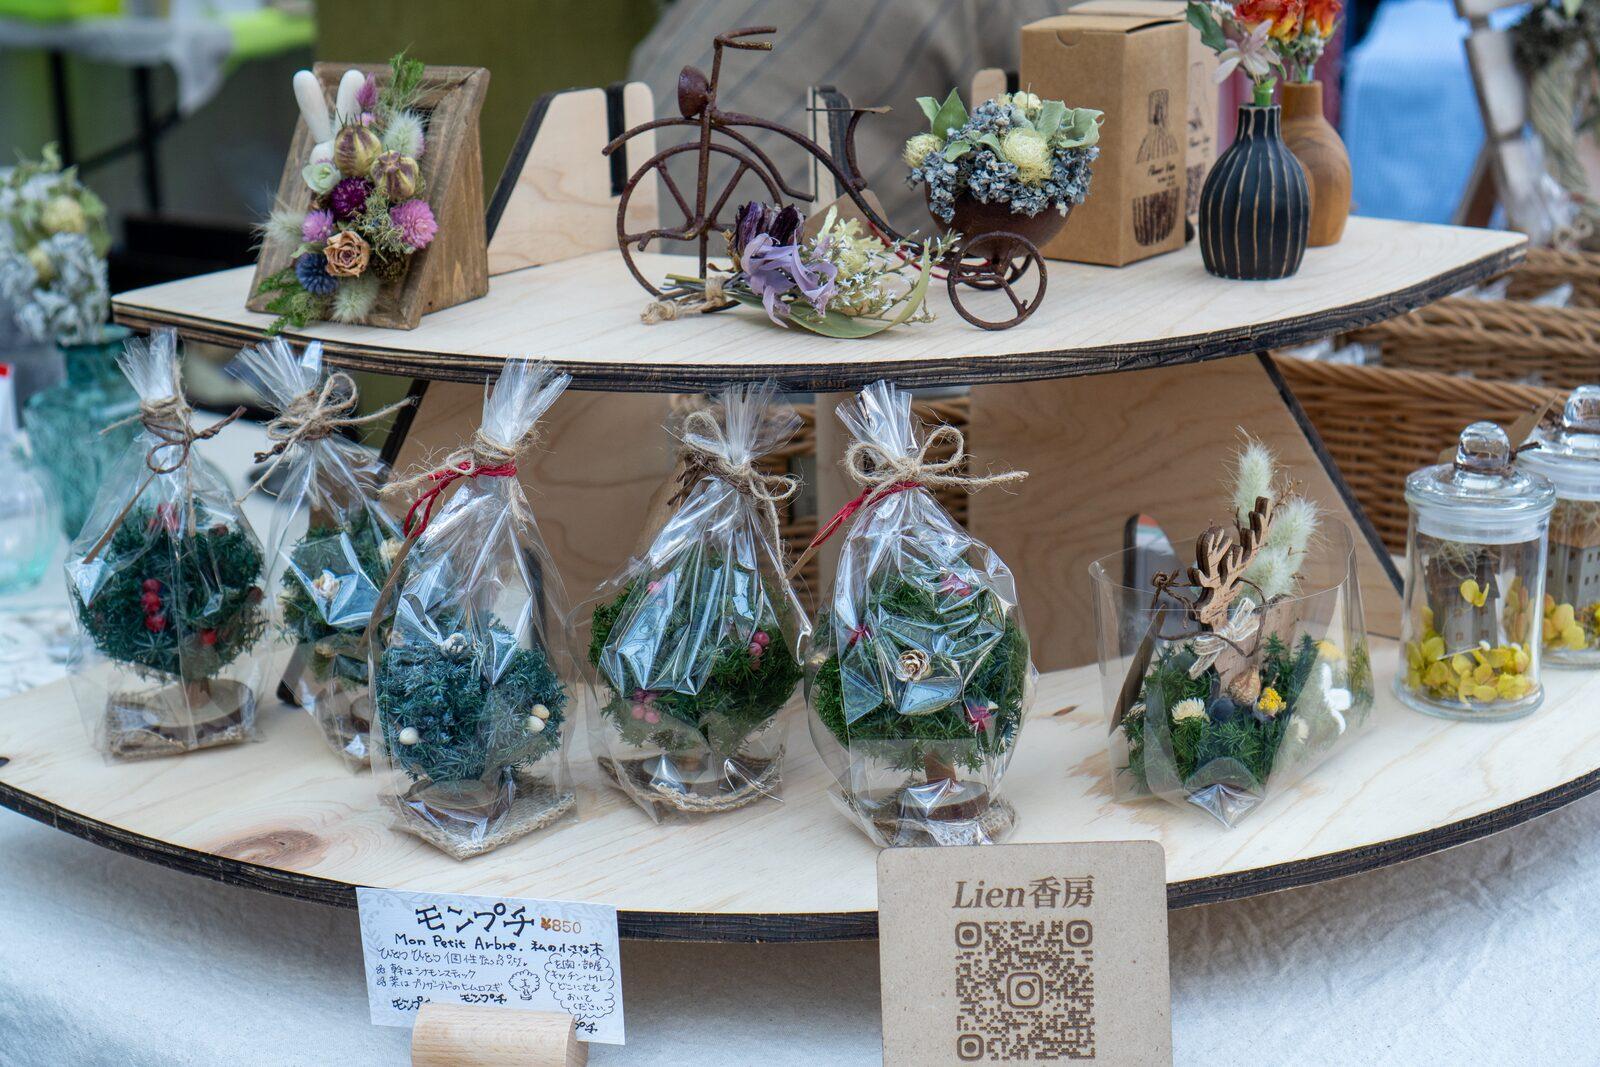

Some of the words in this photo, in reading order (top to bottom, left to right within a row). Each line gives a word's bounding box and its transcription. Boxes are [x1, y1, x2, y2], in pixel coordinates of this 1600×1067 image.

[952, 875, 1095, 909] Lien香房
[415, 902, 535, 937] モンプチ
[540, 916, 582, 935] ¥850
[395, 933, 426, 946] Mon
[432, 935, 466, 949] Petit
[531, 940, 604, 956] 私の小さな木
[557, 982, 601, 992] どこにでも
[460, 993, 508, 1004] モンプチ
[567, 993, 592, 1002] おいて
